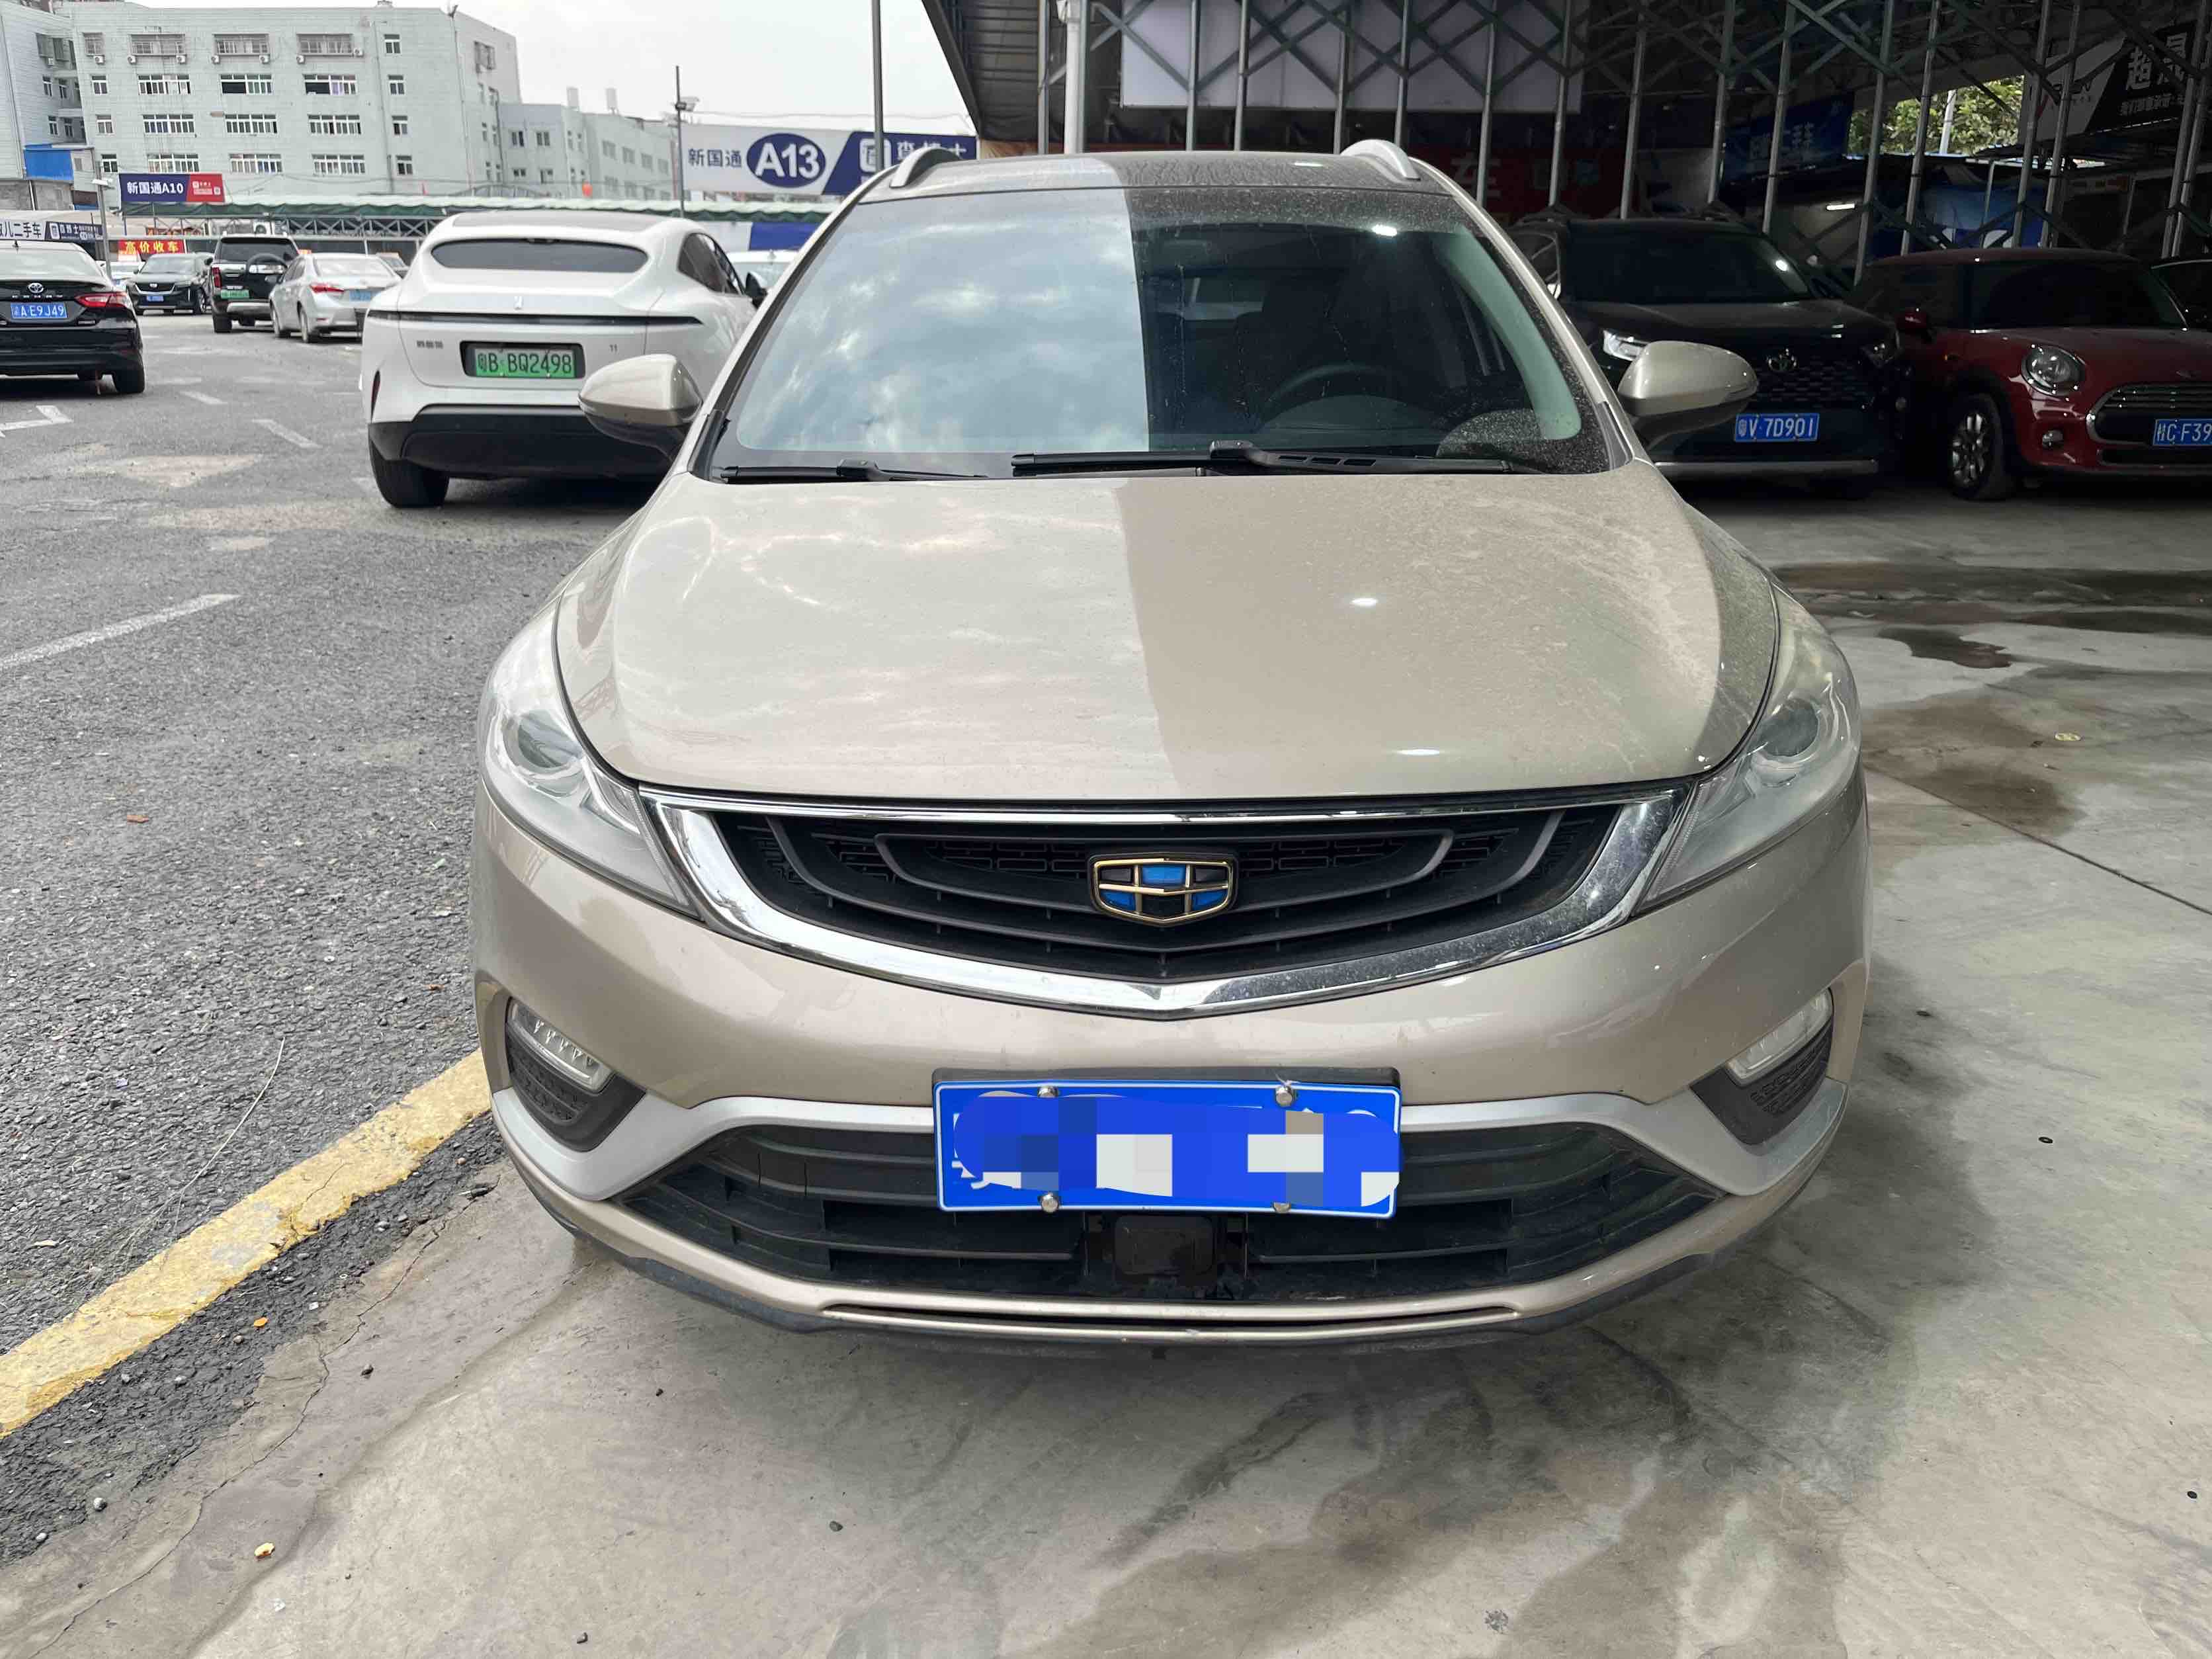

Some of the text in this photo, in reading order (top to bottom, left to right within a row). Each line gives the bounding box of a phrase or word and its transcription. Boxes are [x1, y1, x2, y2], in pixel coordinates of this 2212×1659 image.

[687, 142, 820, 179] 新国通 A13
[126, 181, 184, 194] 新国通A10
[124, 241, 179, 254] 高价收车
